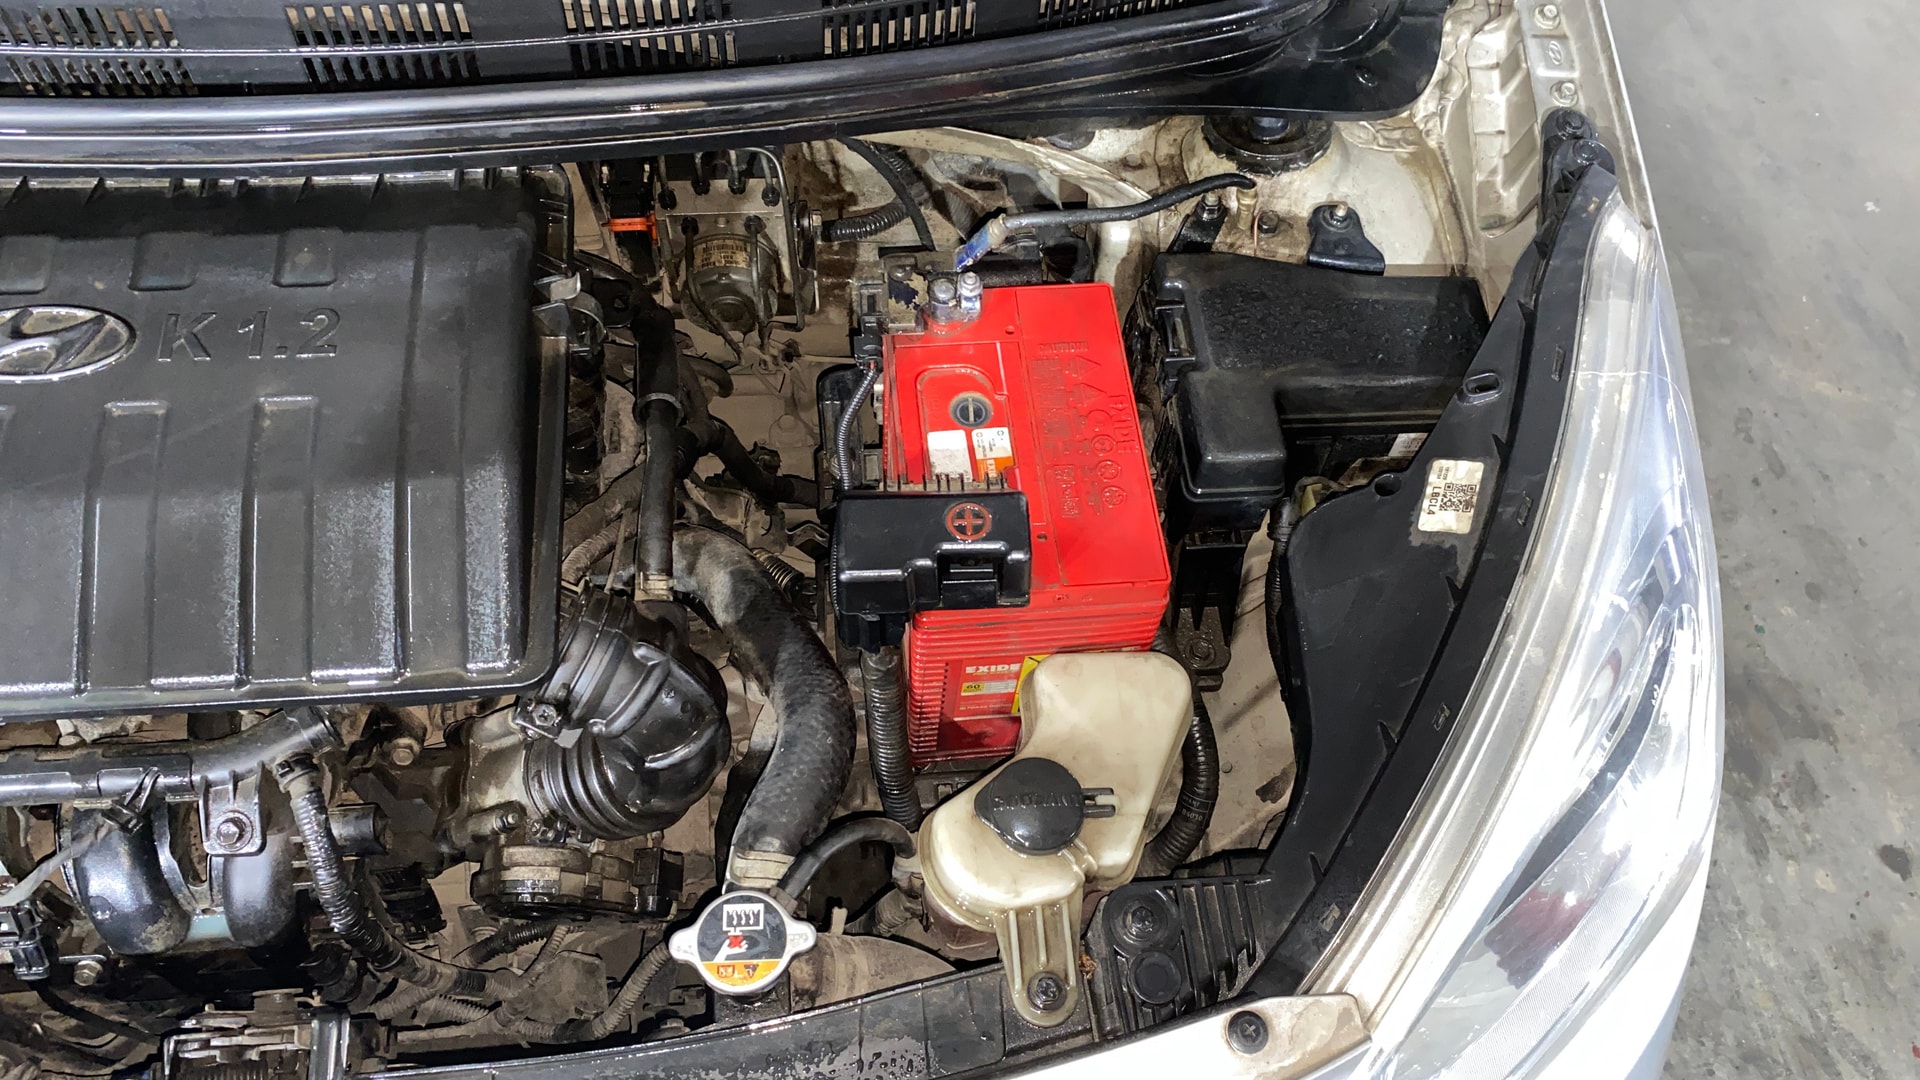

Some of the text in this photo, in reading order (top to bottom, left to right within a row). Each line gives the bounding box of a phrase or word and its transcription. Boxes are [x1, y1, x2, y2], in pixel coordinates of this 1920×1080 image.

[157, 307, 341, 361] K 1.2
[965, 663, 1021, 674] EXIDE
